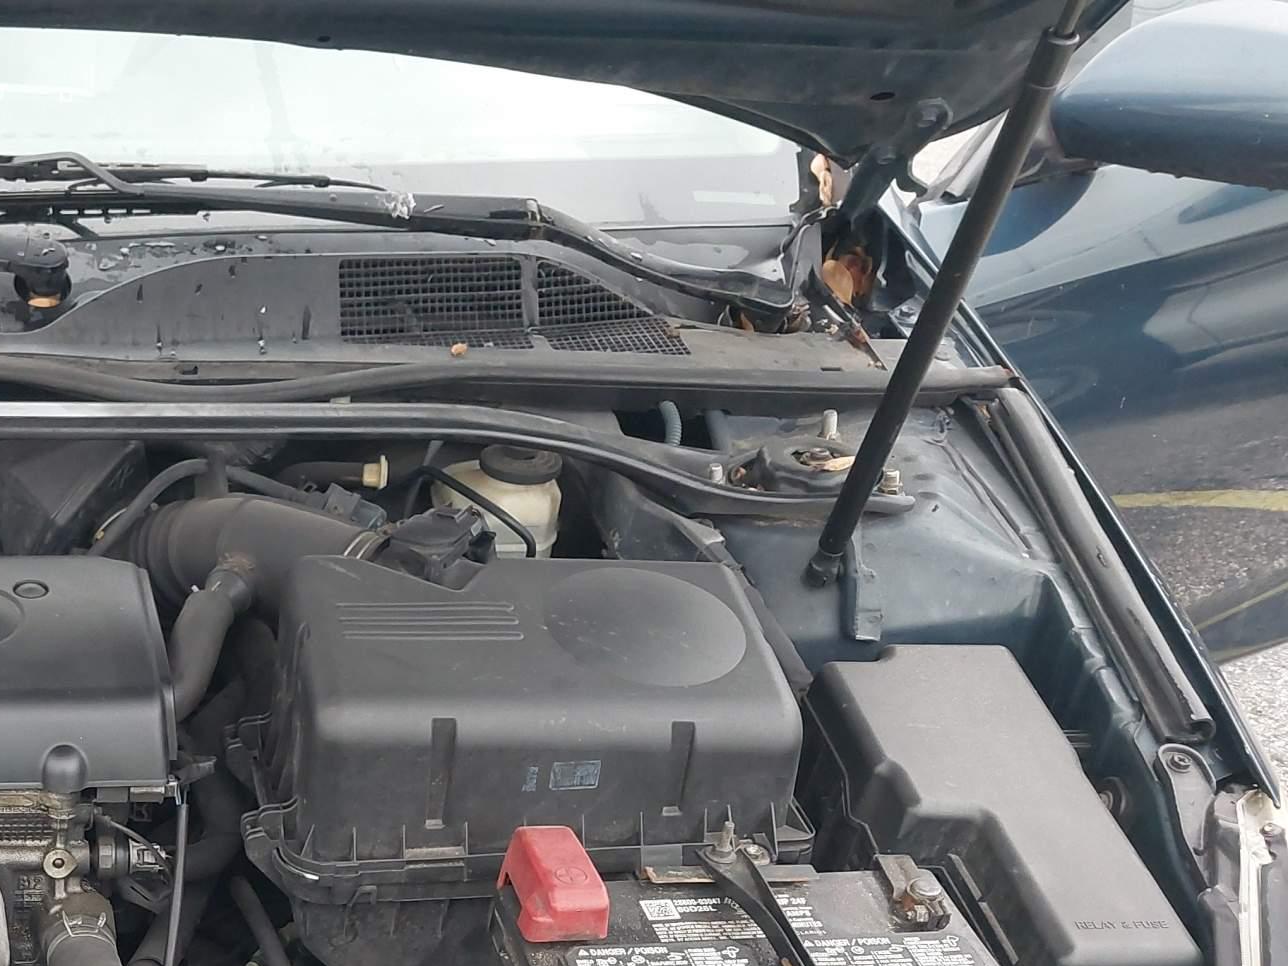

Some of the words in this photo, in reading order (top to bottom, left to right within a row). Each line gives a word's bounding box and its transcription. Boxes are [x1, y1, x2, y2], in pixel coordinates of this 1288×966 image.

[1074, 920, 1117, 930] RELAY
[1132, 920, 1169, 929] FUSE
[814, 939, 850, 947] DANGER
[856, 937, 891, 945] POISON
[589, 948, 627, 956] DANGER
[634, 946, 669, 955] POISON
